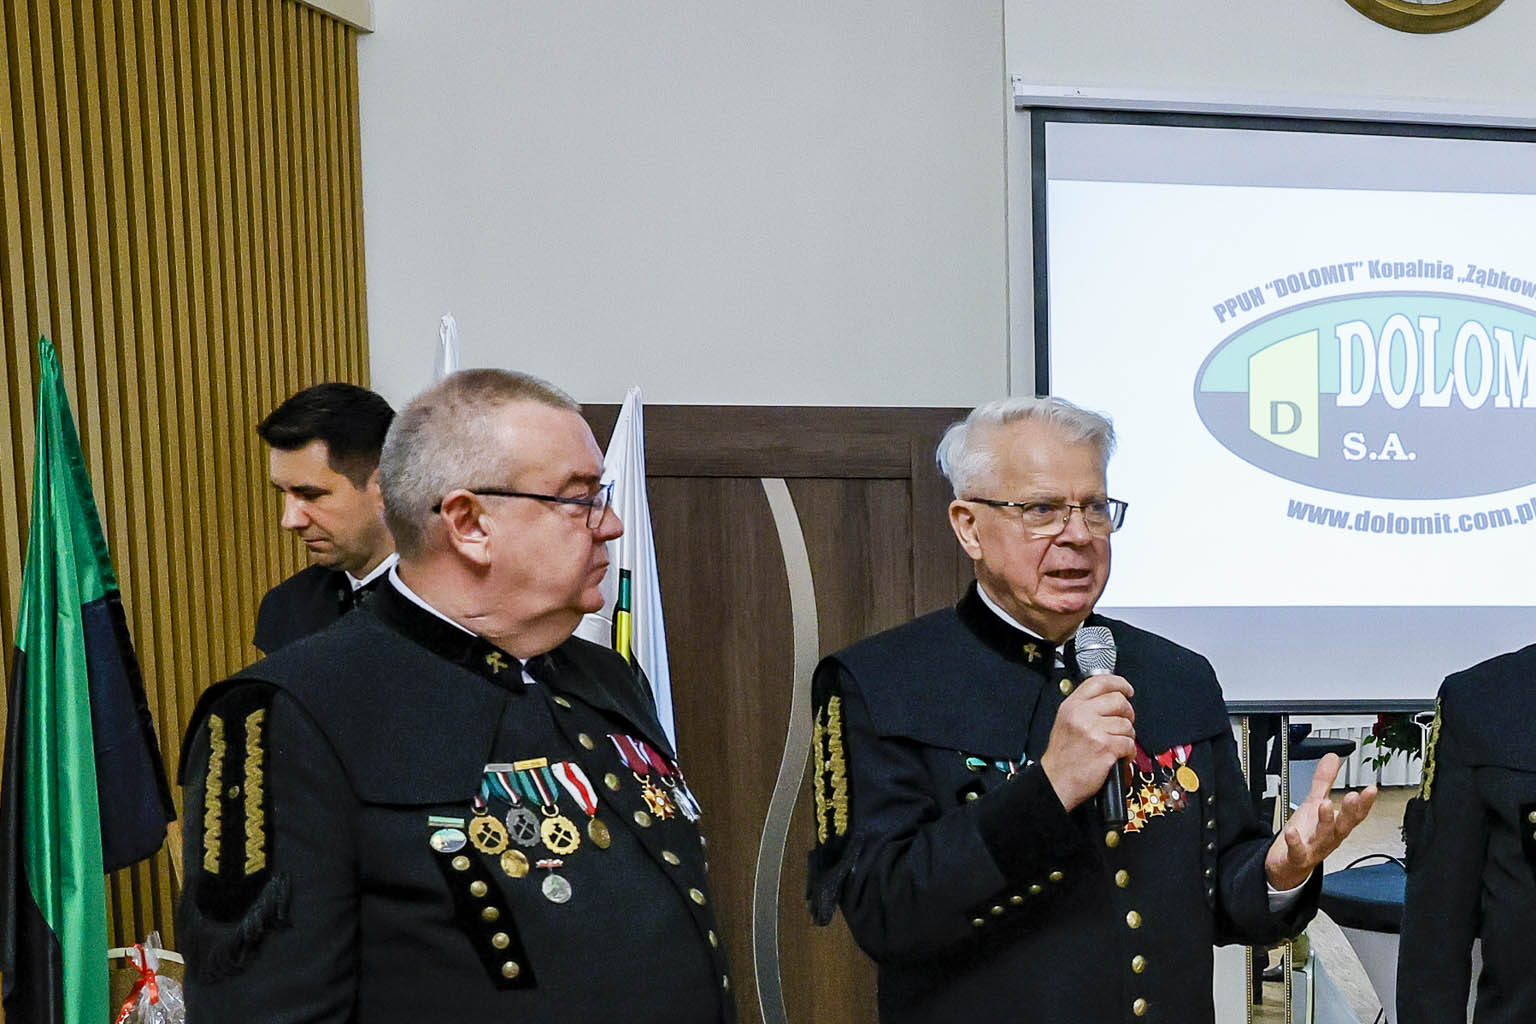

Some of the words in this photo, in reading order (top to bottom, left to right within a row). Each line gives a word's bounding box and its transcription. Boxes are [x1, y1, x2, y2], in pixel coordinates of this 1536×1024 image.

[1212, 286, 1266, 324] PPUH
[1368, 259, 1454, 280] Kopalnia
[1269, 400, 1303, 435] D
[1342, 431, 1417, 461] S.A.
